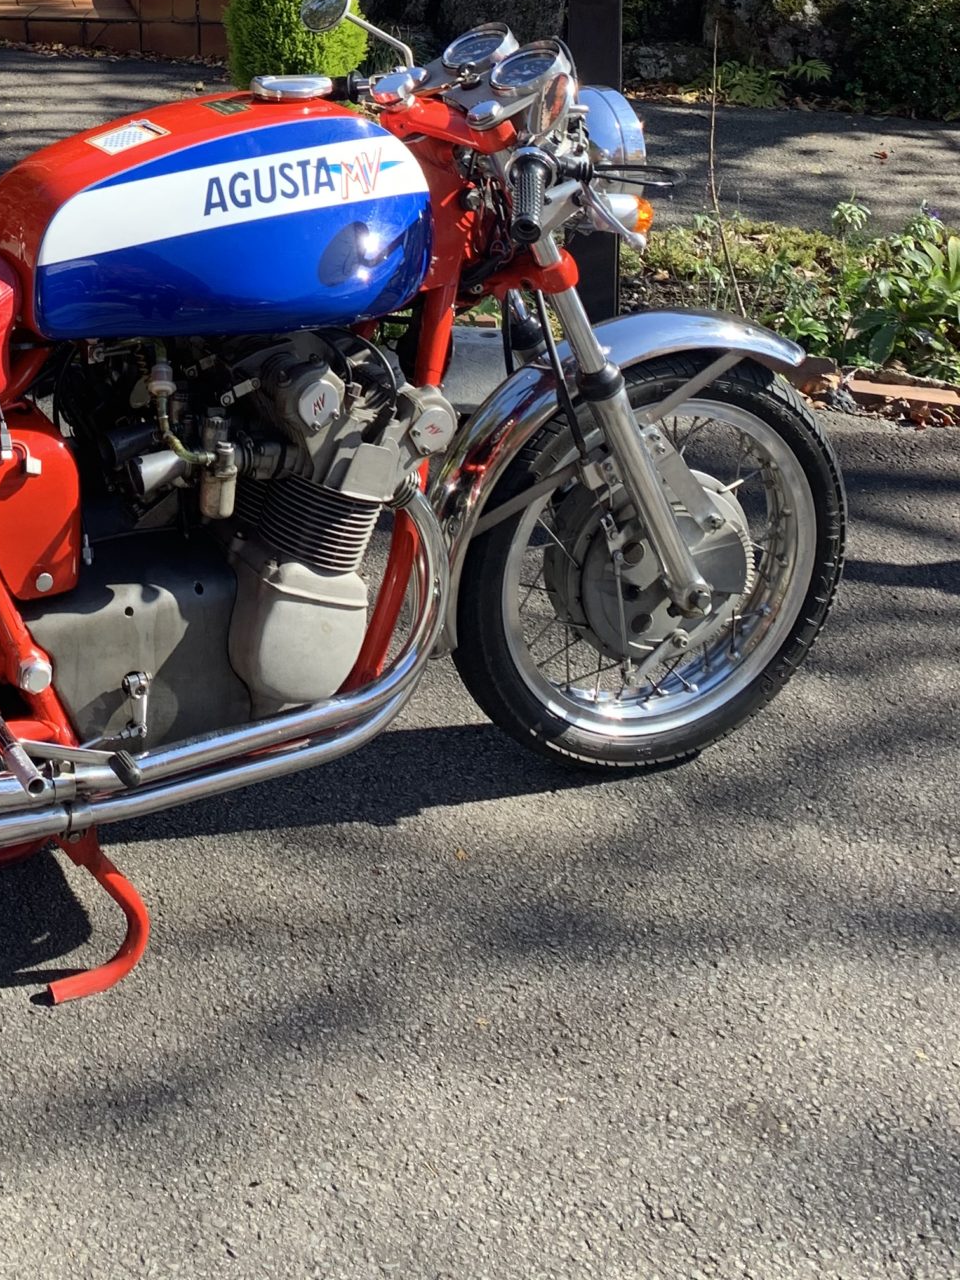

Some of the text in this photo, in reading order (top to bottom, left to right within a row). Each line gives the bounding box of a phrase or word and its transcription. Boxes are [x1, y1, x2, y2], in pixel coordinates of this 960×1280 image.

[203, 147, 383, 216] AGUSTA MV
[312, 392, 326, 416] MV
[424, 423, 443, 435] MV
